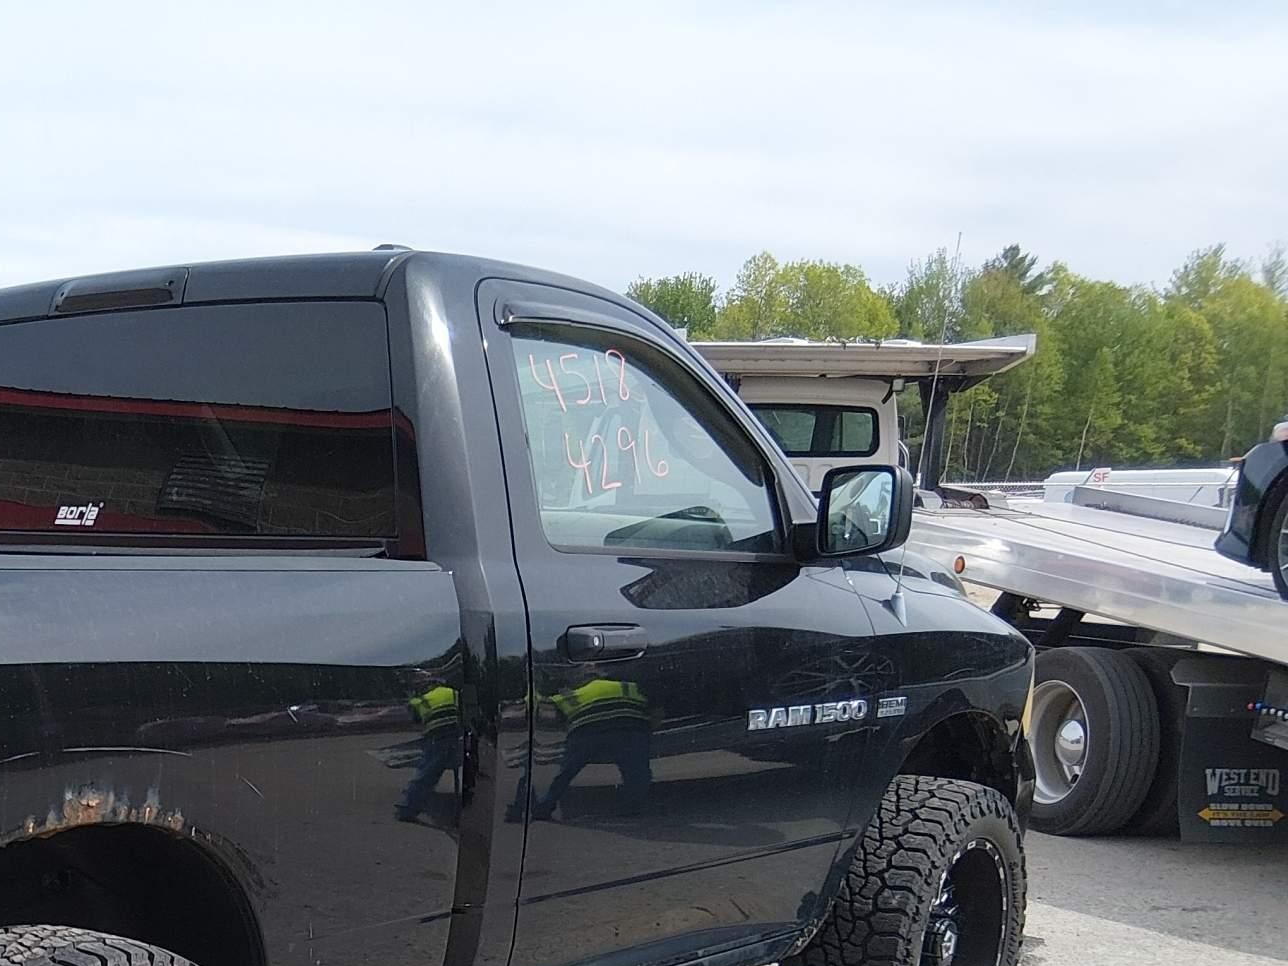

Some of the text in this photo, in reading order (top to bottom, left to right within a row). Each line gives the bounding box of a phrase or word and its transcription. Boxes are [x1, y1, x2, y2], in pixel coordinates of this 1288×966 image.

[528, 348, 631, 413] 4518
[564, 426, 670, 494] 4296
[1093, 472, 1110, 483] SF
[747, 699, 868, 731] RAM 1500
[1205, 768, 1280, 796] WEST END
